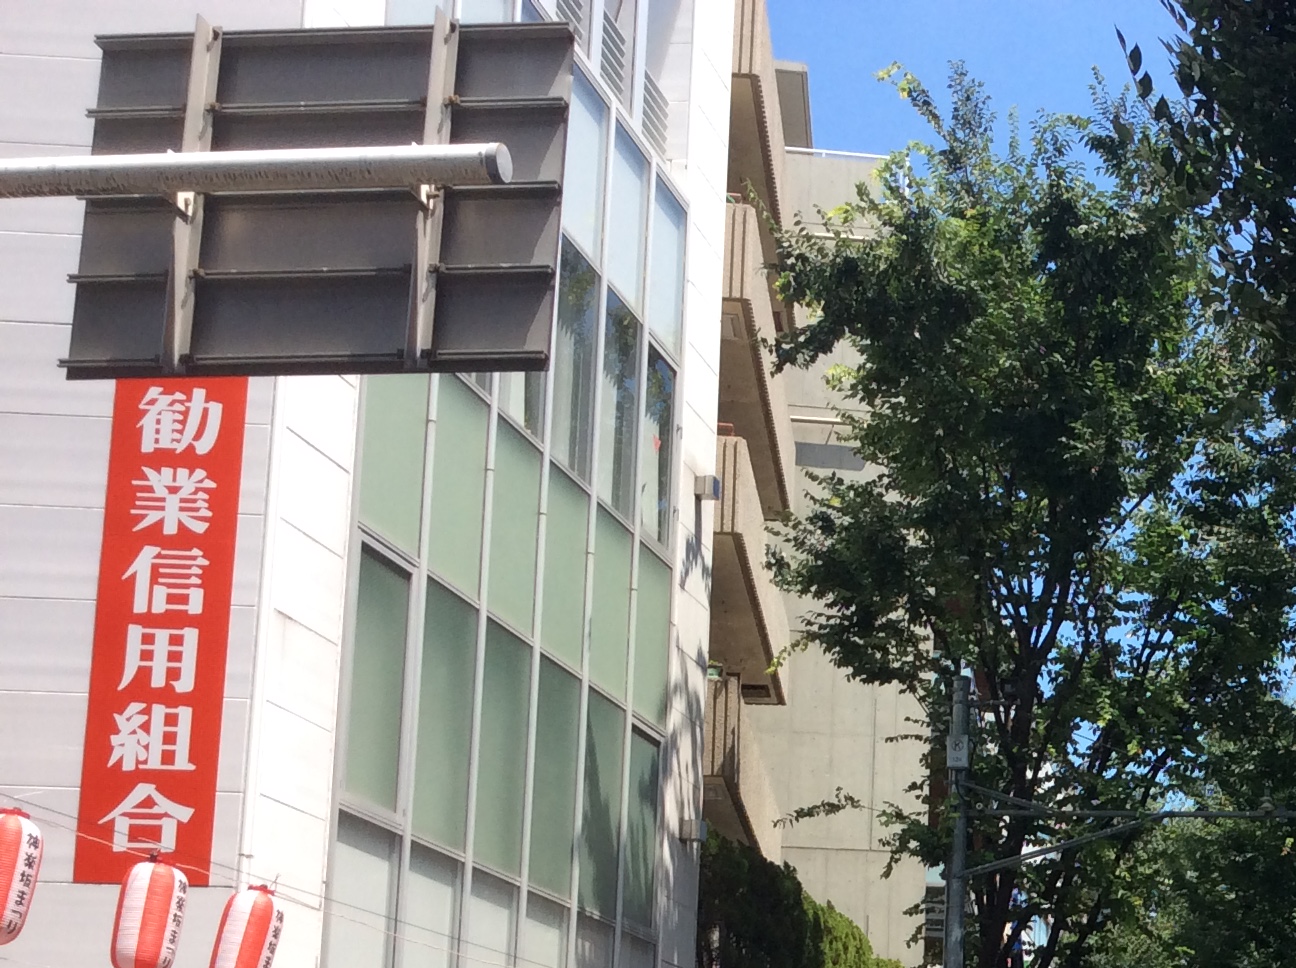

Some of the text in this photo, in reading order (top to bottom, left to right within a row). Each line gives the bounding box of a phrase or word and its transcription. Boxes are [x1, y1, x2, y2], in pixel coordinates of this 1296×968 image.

[97, 386, 223, 854] 勧業信用組合
[7, 832, 40, 935] 神楽坂まつり
